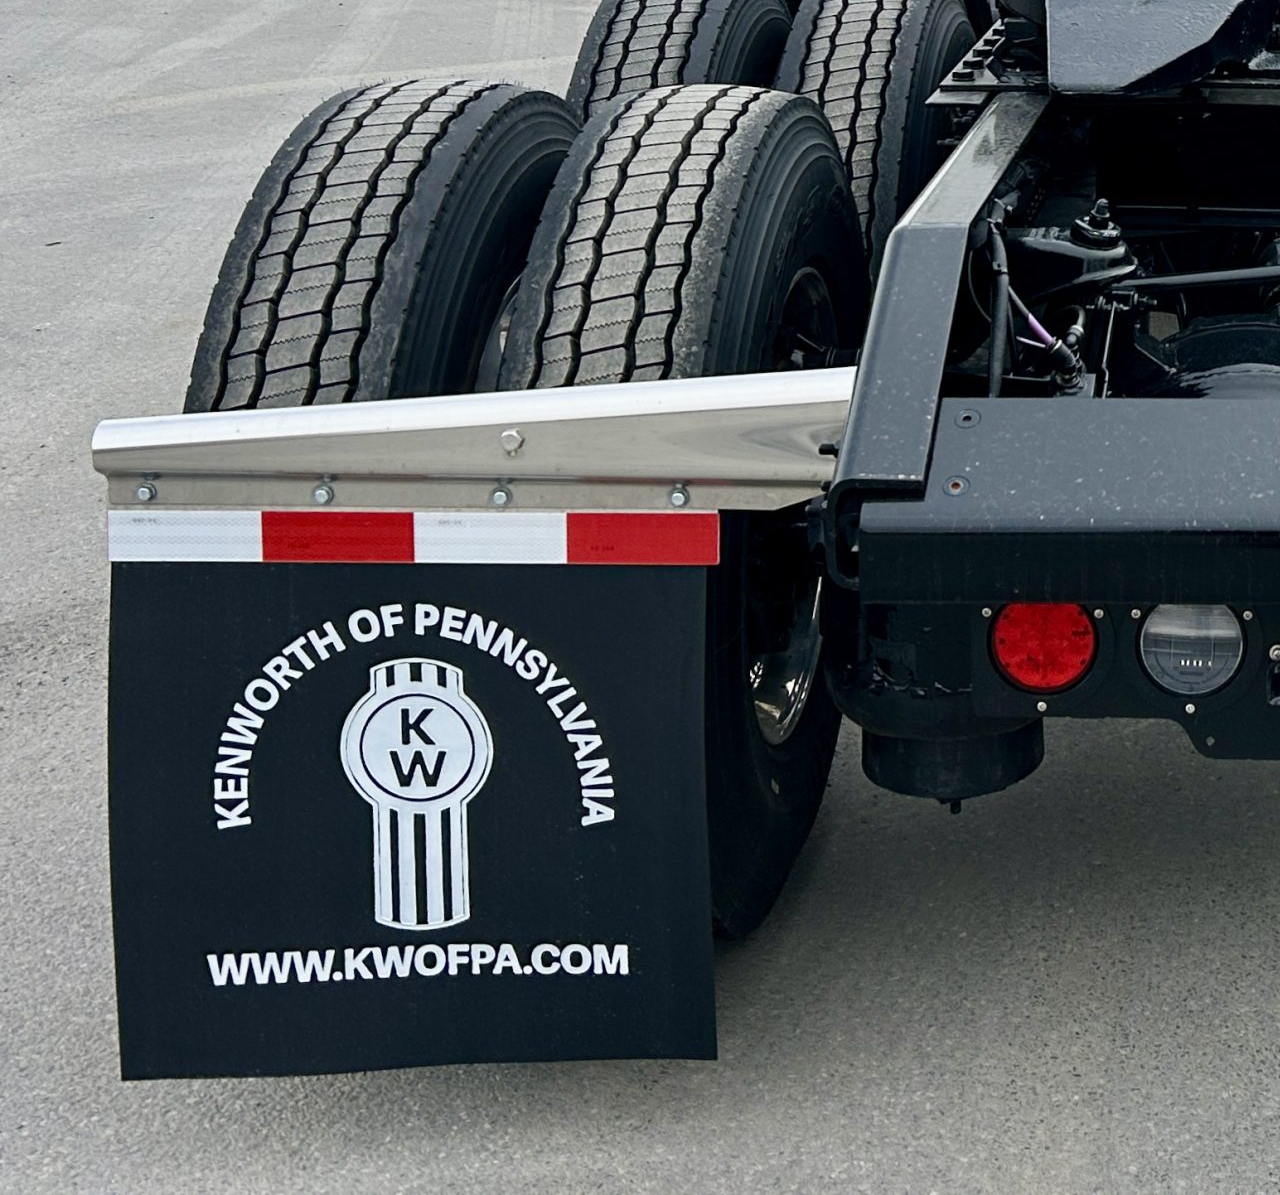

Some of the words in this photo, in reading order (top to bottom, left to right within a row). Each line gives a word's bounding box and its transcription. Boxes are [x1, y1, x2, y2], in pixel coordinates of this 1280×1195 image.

[213, 621, 347, 830] KENWORTH
[347, 603, 404, 643] OF
[414, 603, 615, 827] PENNSYLVANIA
[400, 708, 436, 746] K
[389, 750, 447, 788] W
[206, 943, 630, 987] WWW.KWOFPA.COM
